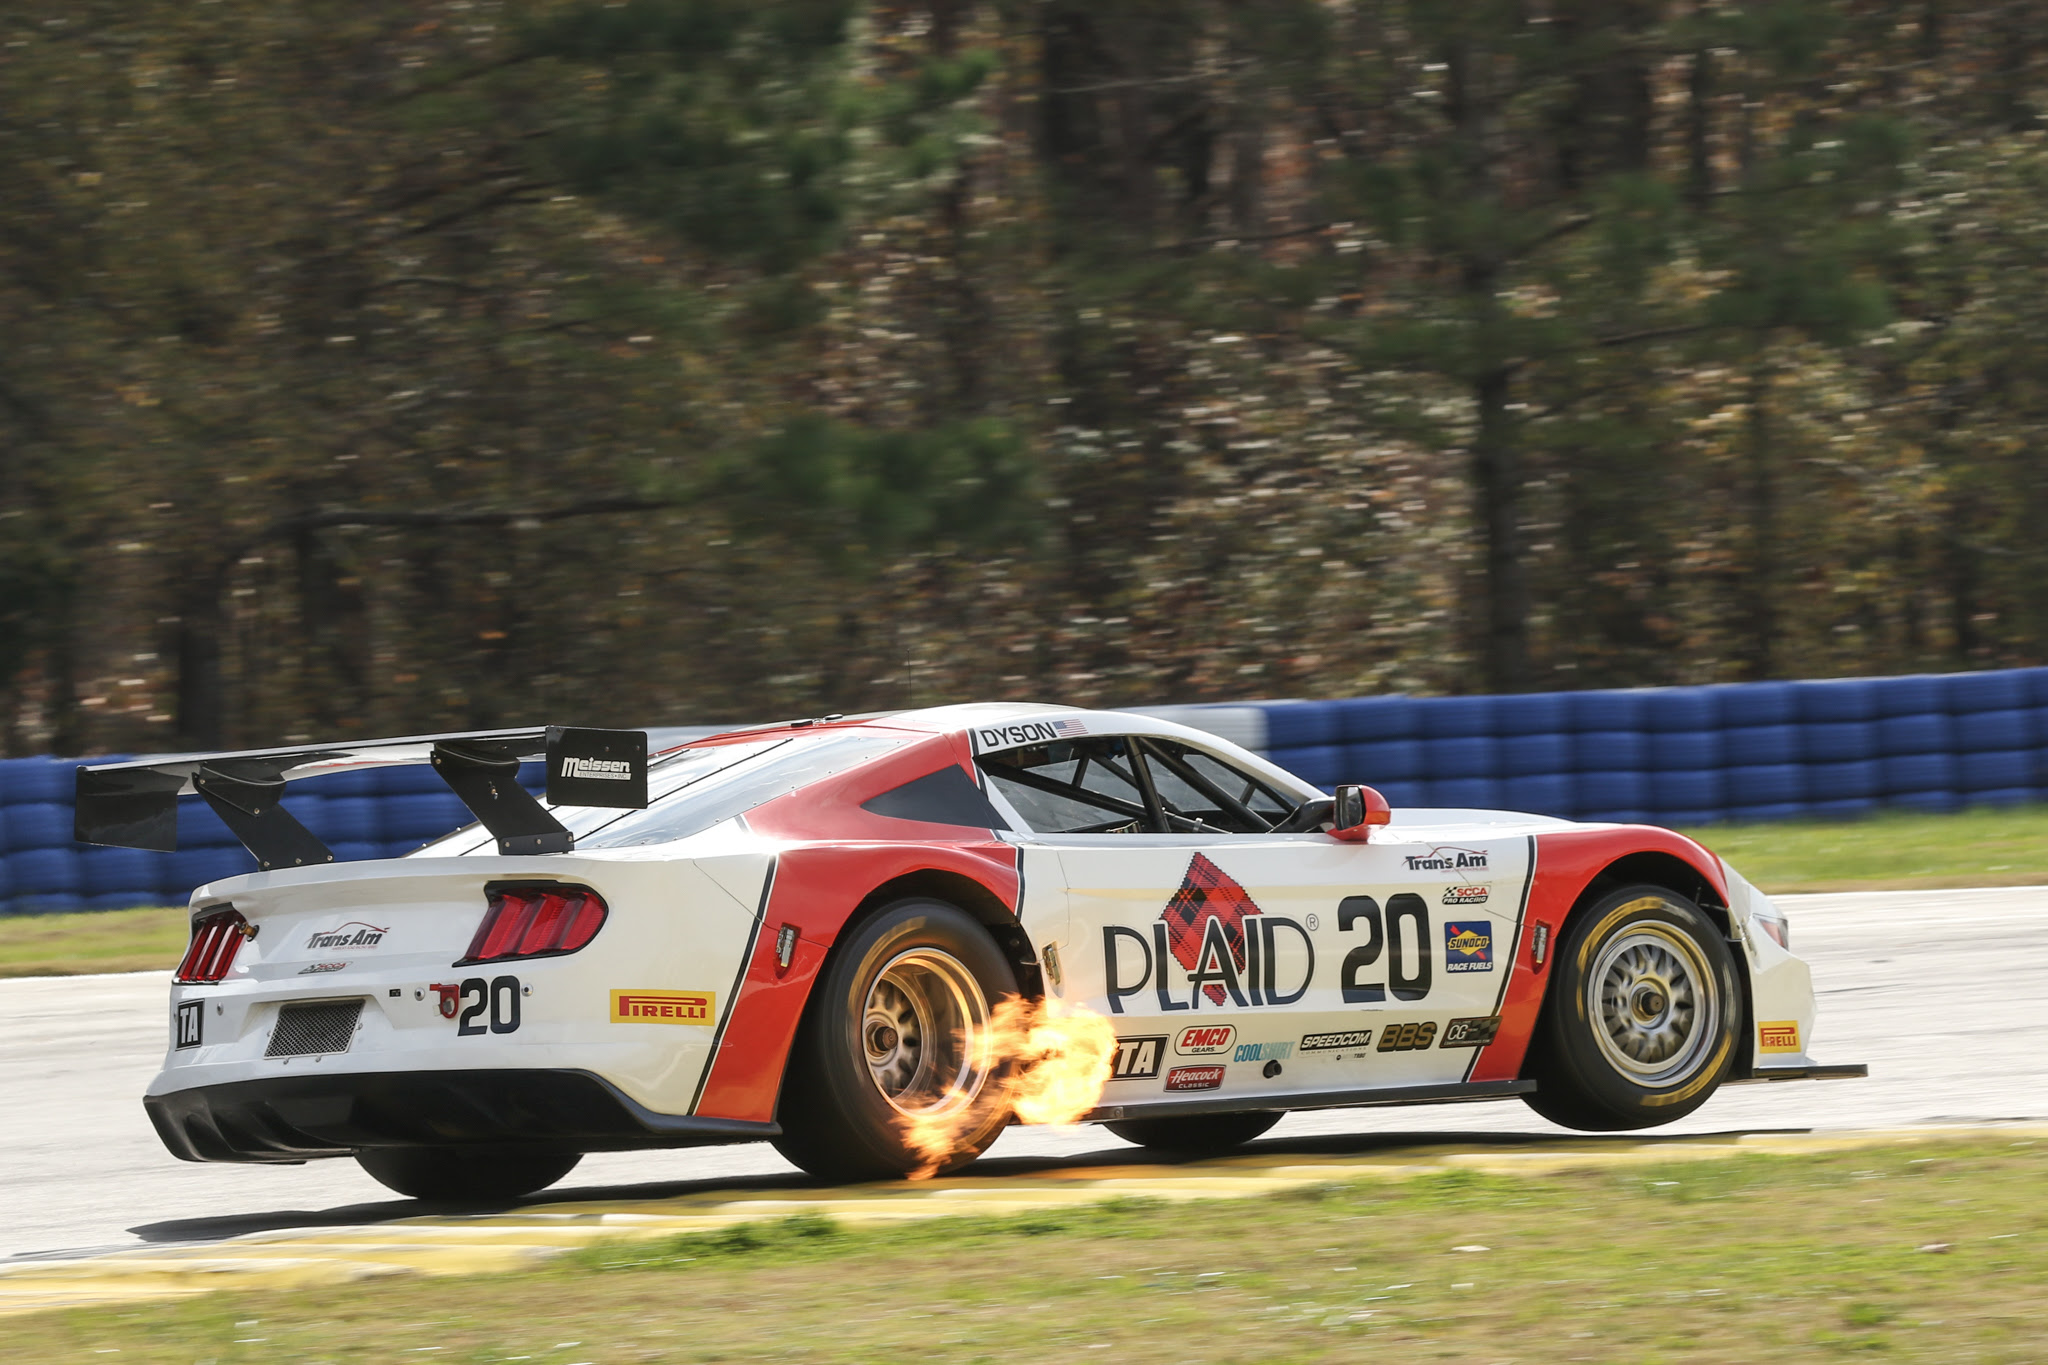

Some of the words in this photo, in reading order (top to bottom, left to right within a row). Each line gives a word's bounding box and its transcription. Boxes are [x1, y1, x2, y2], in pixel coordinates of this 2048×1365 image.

[979, 722, 1057, 747] DYSON
[561, 757, 630, 777] Meissen
[1405, 856, 1453, 870] Trans
[1456, 853, 1487, 867] Am
[1457, 887, 1488, 897] SCCA
[1459, 896, 1487, 904] RACING
[307, 932, 351, 949] Trans
[349, 929, 383, 945] Am
[1338, 894, 1432, 1003] 20
[1450, 937, 1487, 948] SUNOCO
[1103, 915, 1314, 1013] PLAID
[1447, 963, 1468, 971] RACE
[1468, 962, 1492, 970] FUELS
[457, 975, 521, 1036] 20
[619, 995, 707, 1019] PIRELLI
[180, 1006, 199, 1044] TA
[1447, 1024, 1469, 1040] CG
[1181, 1028, 1230, 1047] EMCO
[1301, 1032, 1370, 1048] SPEEDCOM
[1379, 1022, 1437, 1051] BBS
[1761, 1028, 1796, 1046] PIRELLI
[1117, 1041, 1157, 1075] TA
[1170, 1069, 1221, 1084] Heacock
